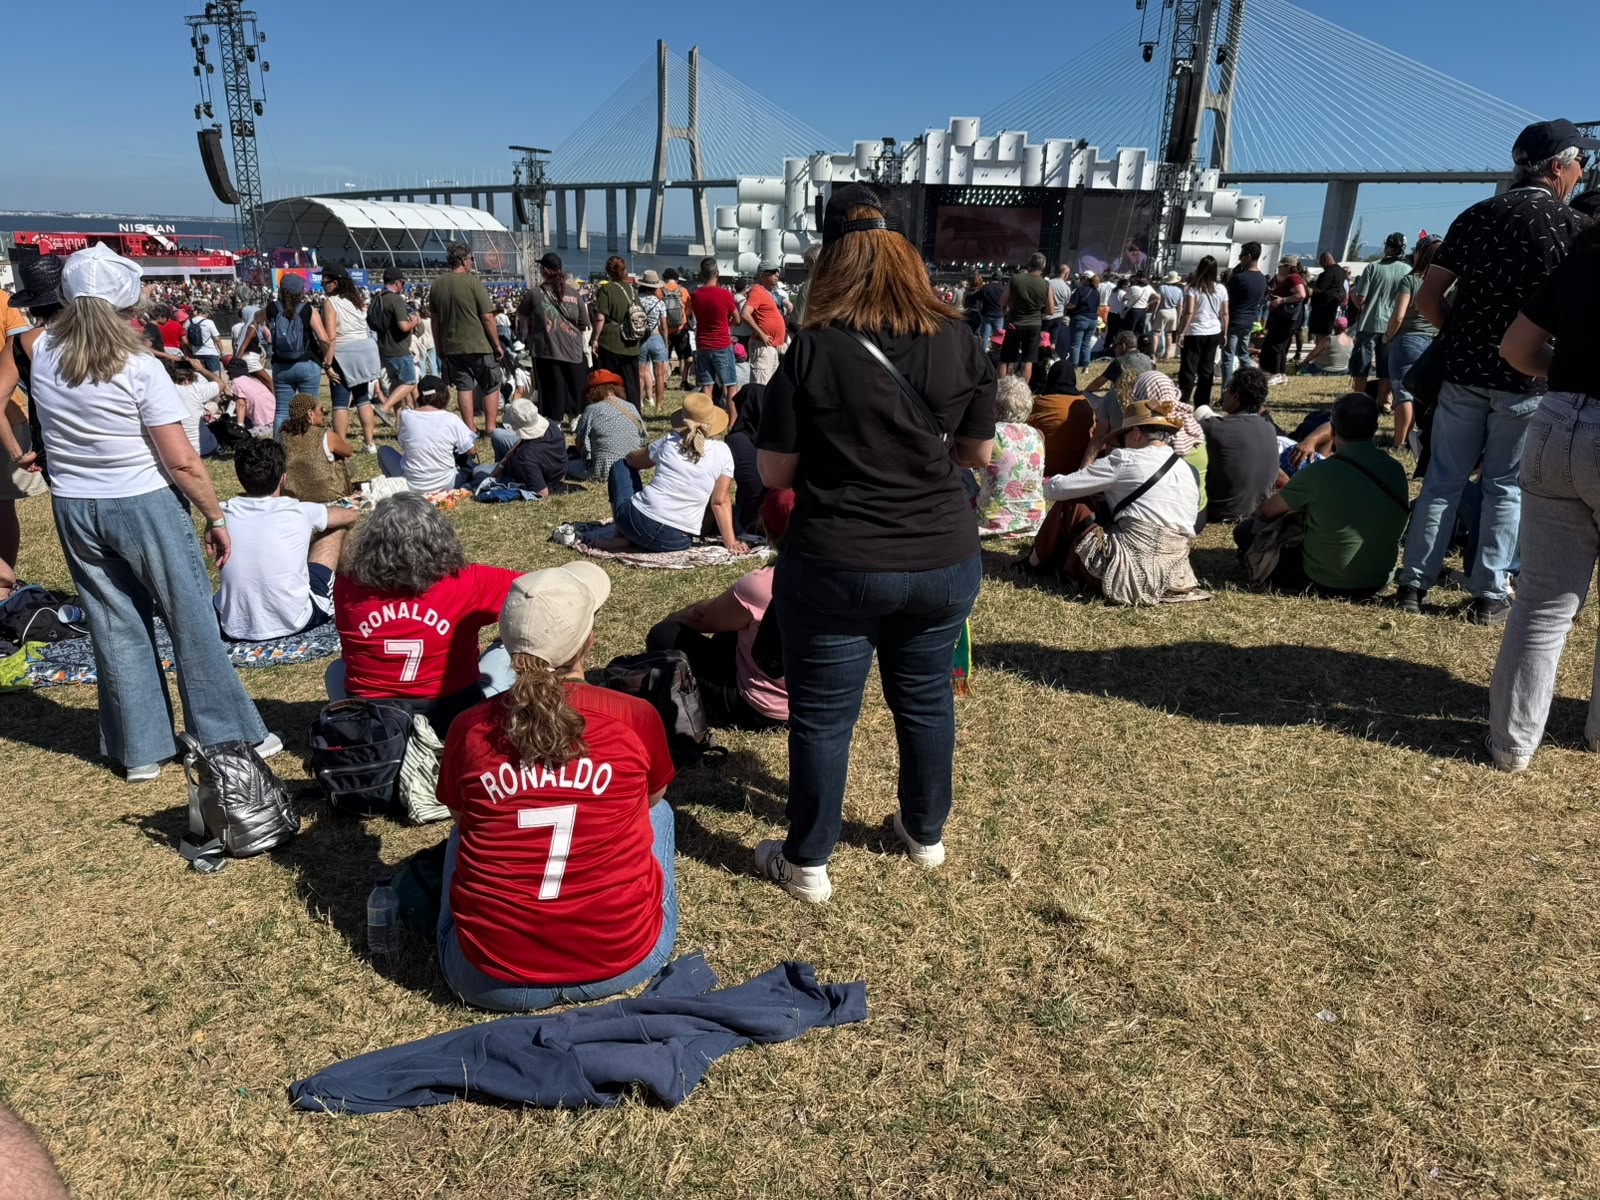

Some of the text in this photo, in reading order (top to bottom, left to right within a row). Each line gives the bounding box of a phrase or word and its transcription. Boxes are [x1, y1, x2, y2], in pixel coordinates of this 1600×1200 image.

[118, 223, 176, 233] NISSAN
[358, 601, 451, 638] RONALDO
[383, 639, 424, 682] 7
[479, 757, 613, 805] RONALDO
[517, 803, 578, 900] 7
